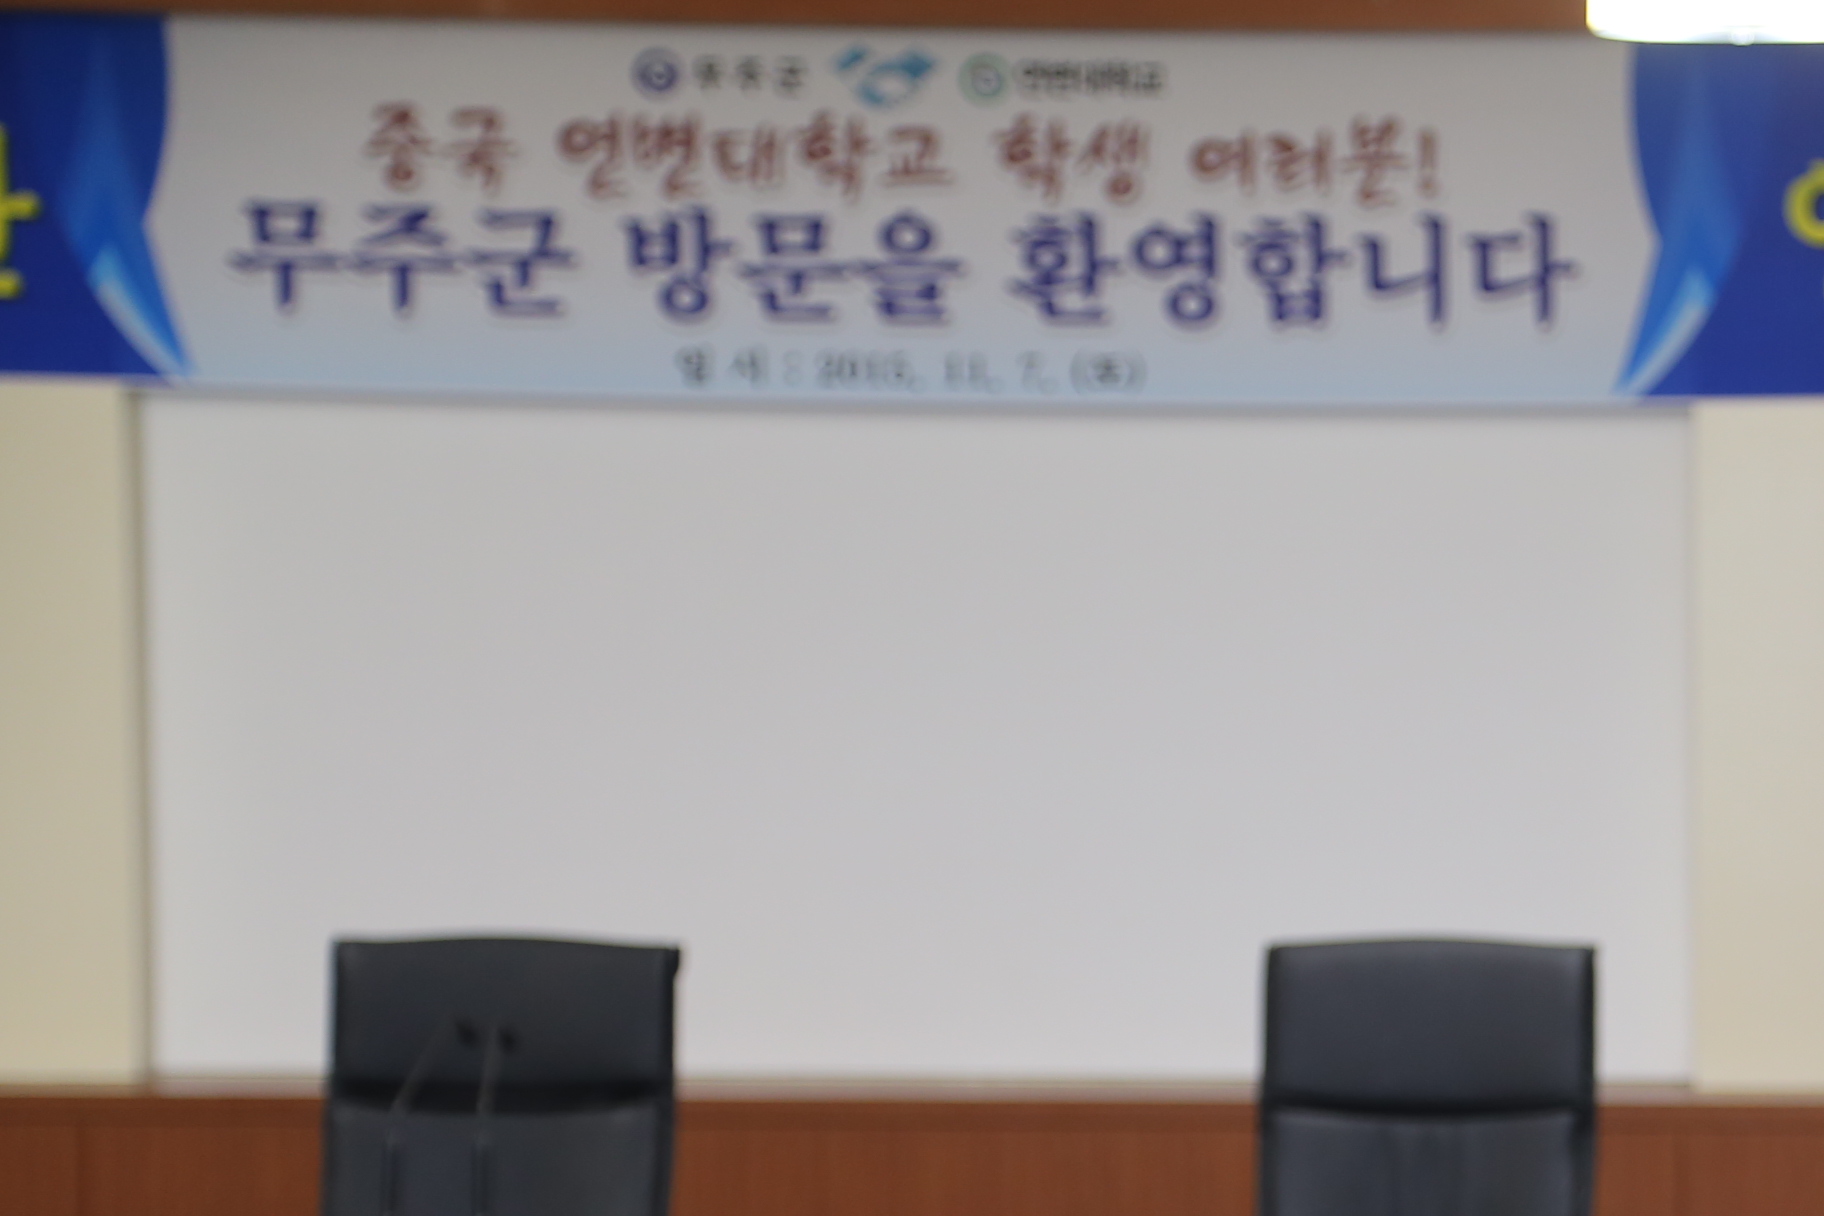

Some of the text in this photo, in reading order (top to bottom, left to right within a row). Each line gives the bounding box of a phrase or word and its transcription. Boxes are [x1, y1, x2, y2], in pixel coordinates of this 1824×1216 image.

[368, 101, 1438, 206] 중국 연변대학교 학생 여러분!
[228, 200, 1579, 330] 무주군 방문을 환영합니다
